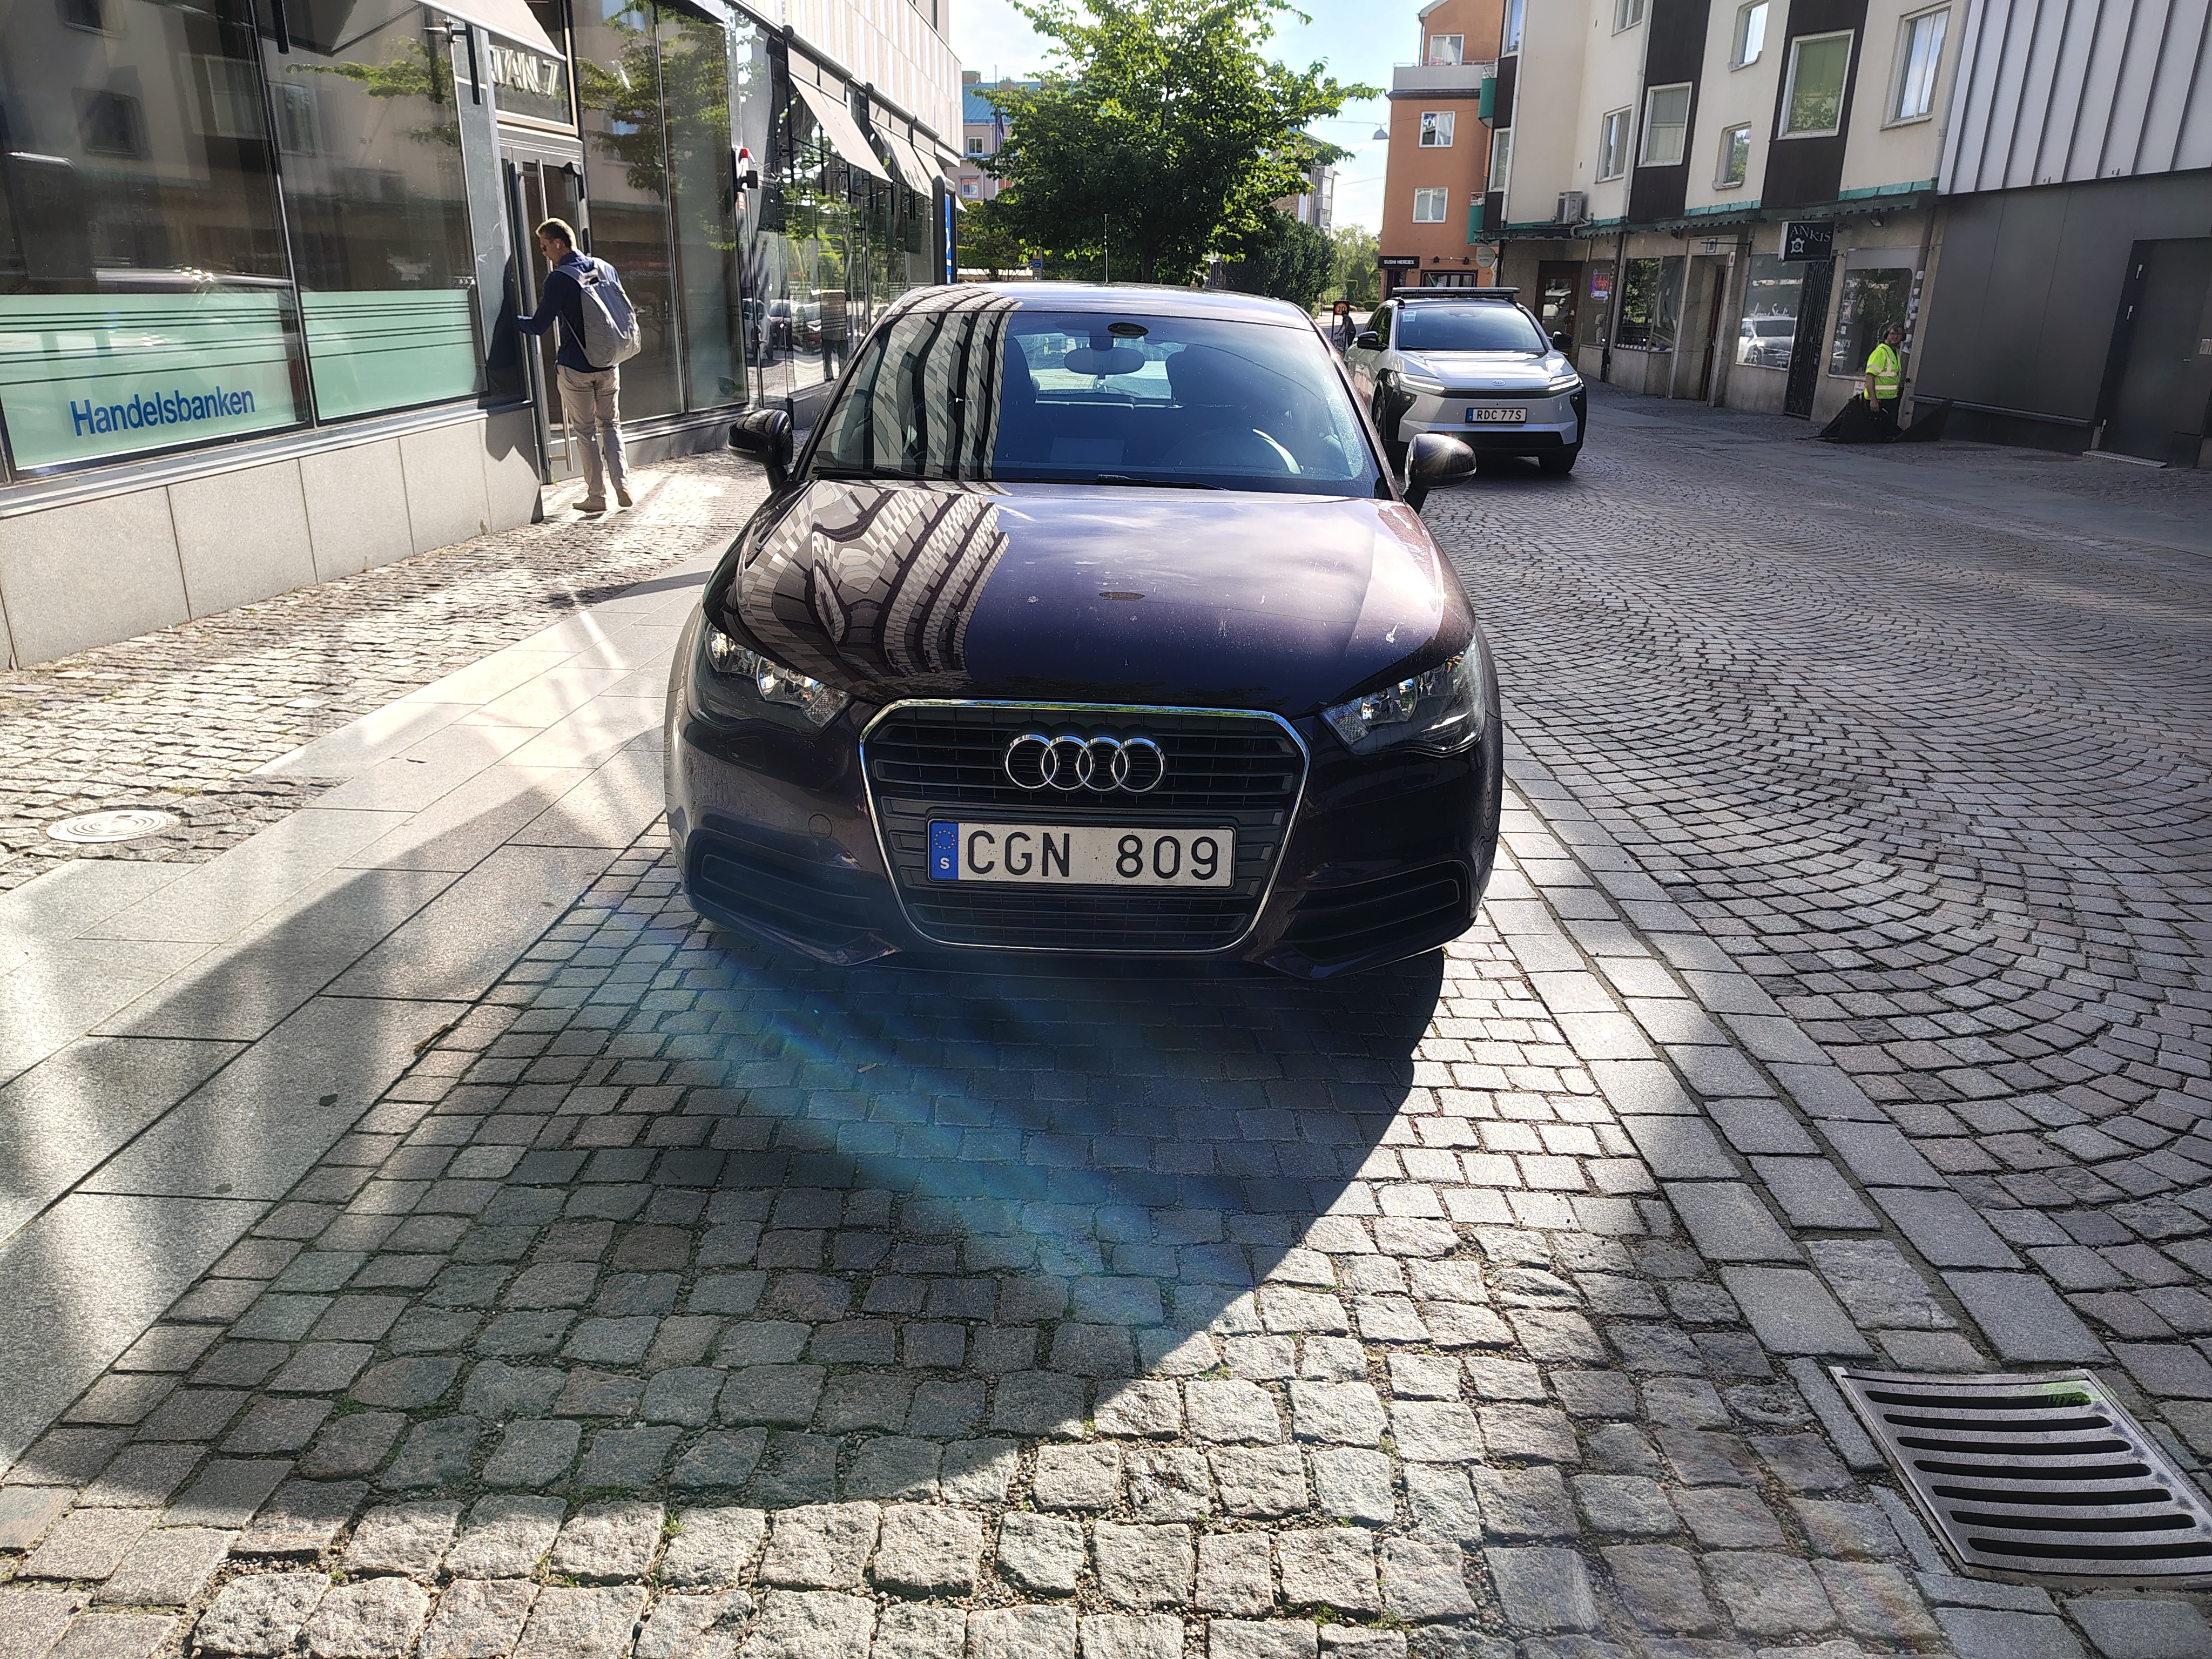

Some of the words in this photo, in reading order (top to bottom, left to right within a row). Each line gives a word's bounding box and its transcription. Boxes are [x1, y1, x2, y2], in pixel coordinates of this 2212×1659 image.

[489, 44, 540, 93] TAN
[542, 59, 560, 96] 7
[1790, 225, 1831, 242] ANKIS
[70, 385, 256, 436] Handelsbanken
[1476, 410, 1498, 420] RDC
[1501, 410, 1522, 420] 77S
[940, 857, 950, 869] S
[967, 830, 1070, 877] CGN
[1116, 834, 1218, 880] 809
